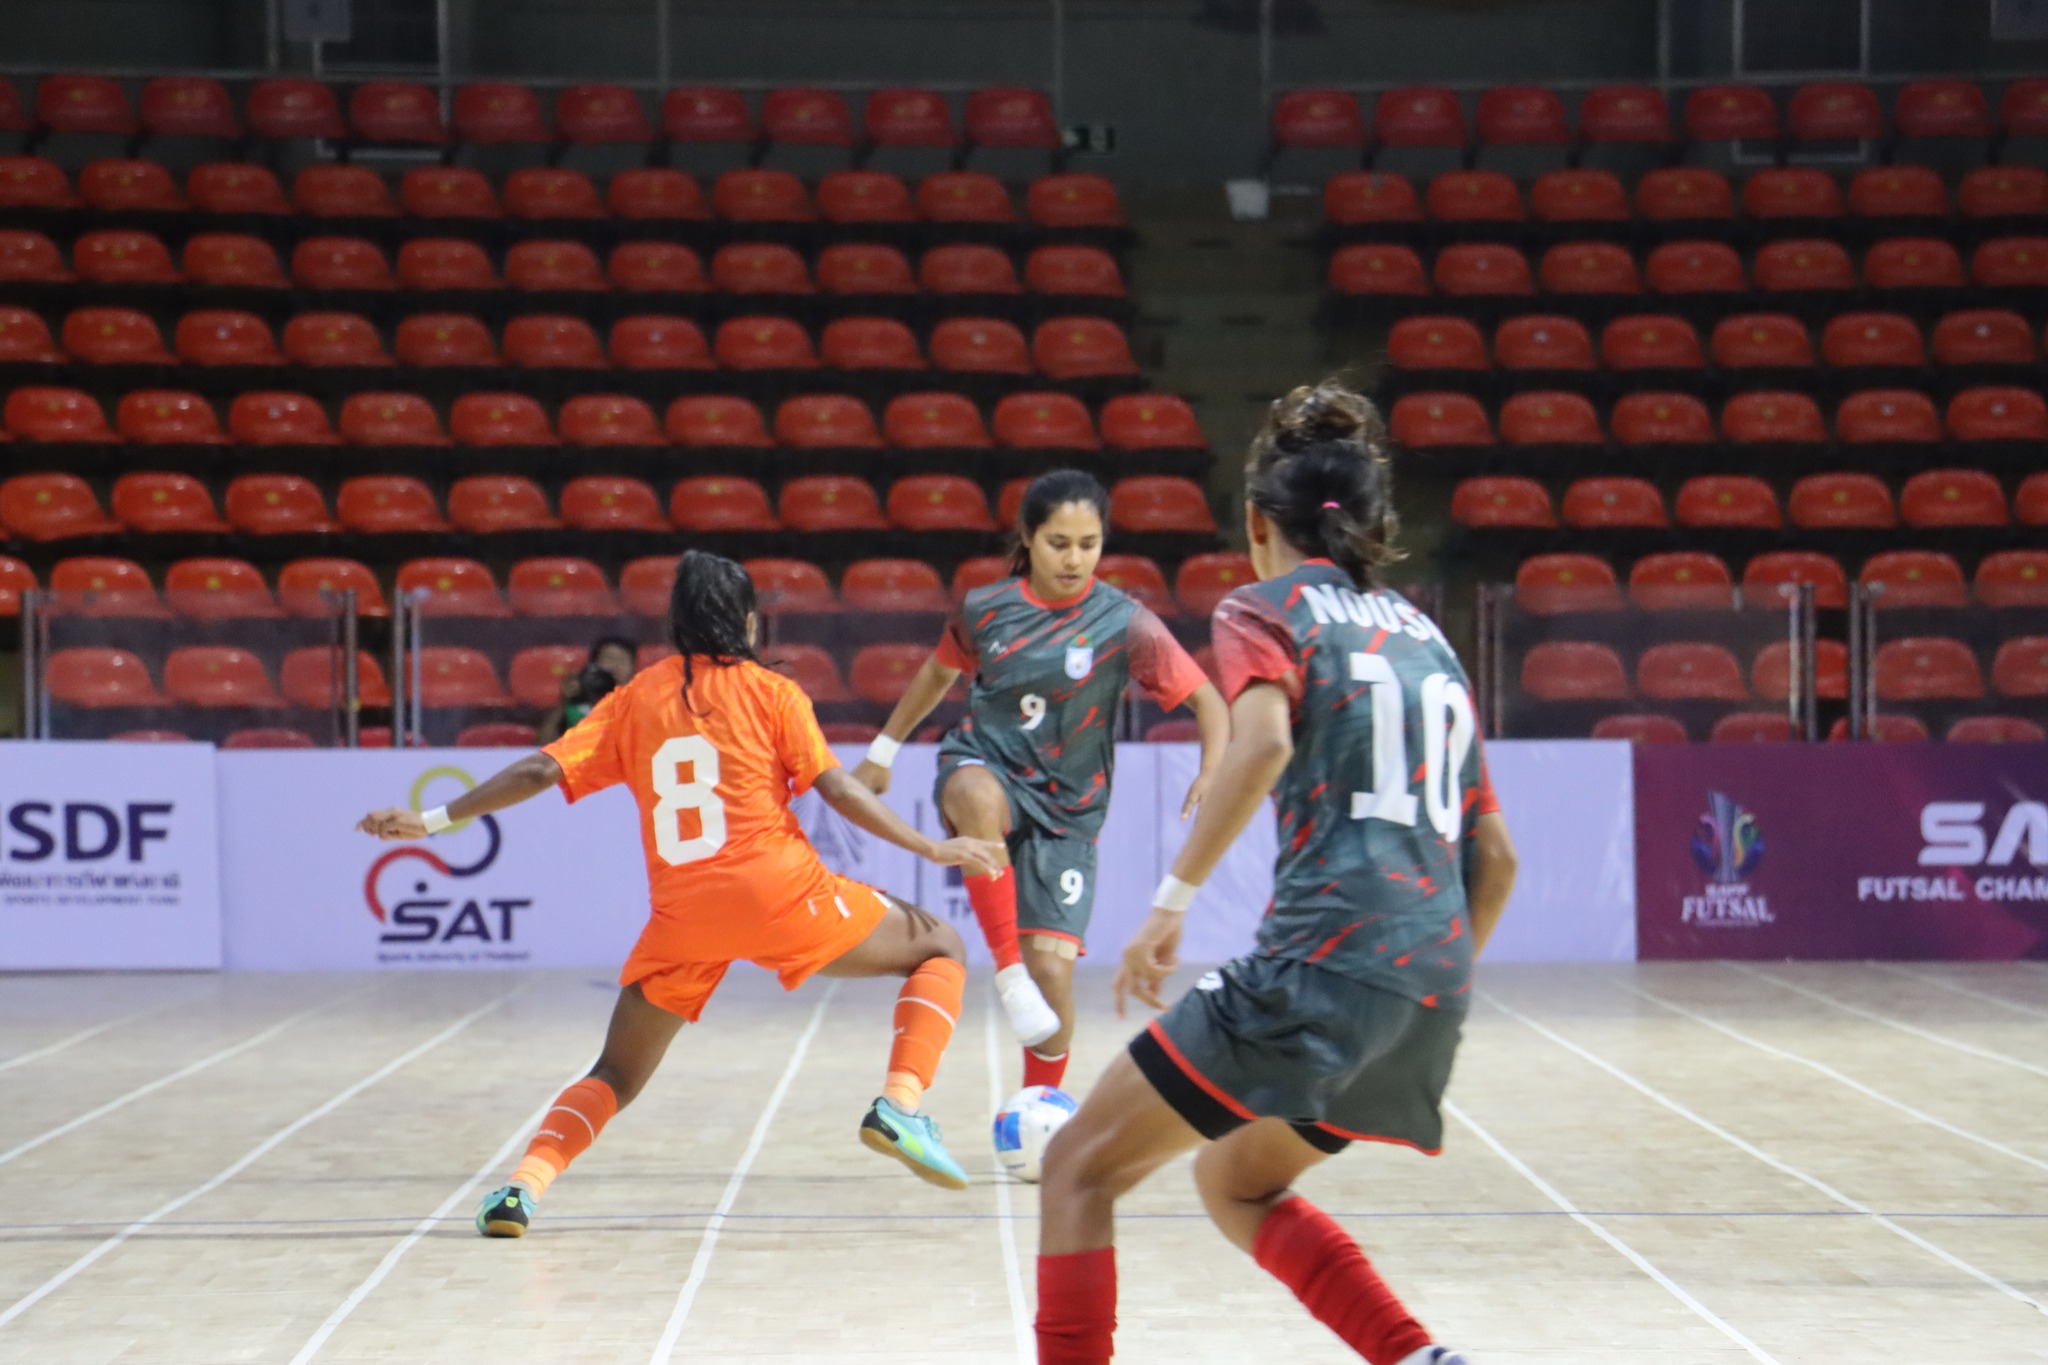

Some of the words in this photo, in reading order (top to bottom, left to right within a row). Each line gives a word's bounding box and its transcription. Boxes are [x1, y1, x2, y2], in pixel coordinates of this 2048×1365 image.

[1019, 693, 1047, 731] 9
[1350, 652, 1474, 843] 10
[651, 734, 728, 866] 8
[1060, 868, 1084, 906] 9
[1857, 876, 1966, 902] FUTSAL
[379, 899, 533, 943] SAT
[1681, 896, 1776, 922] FUTSAL
